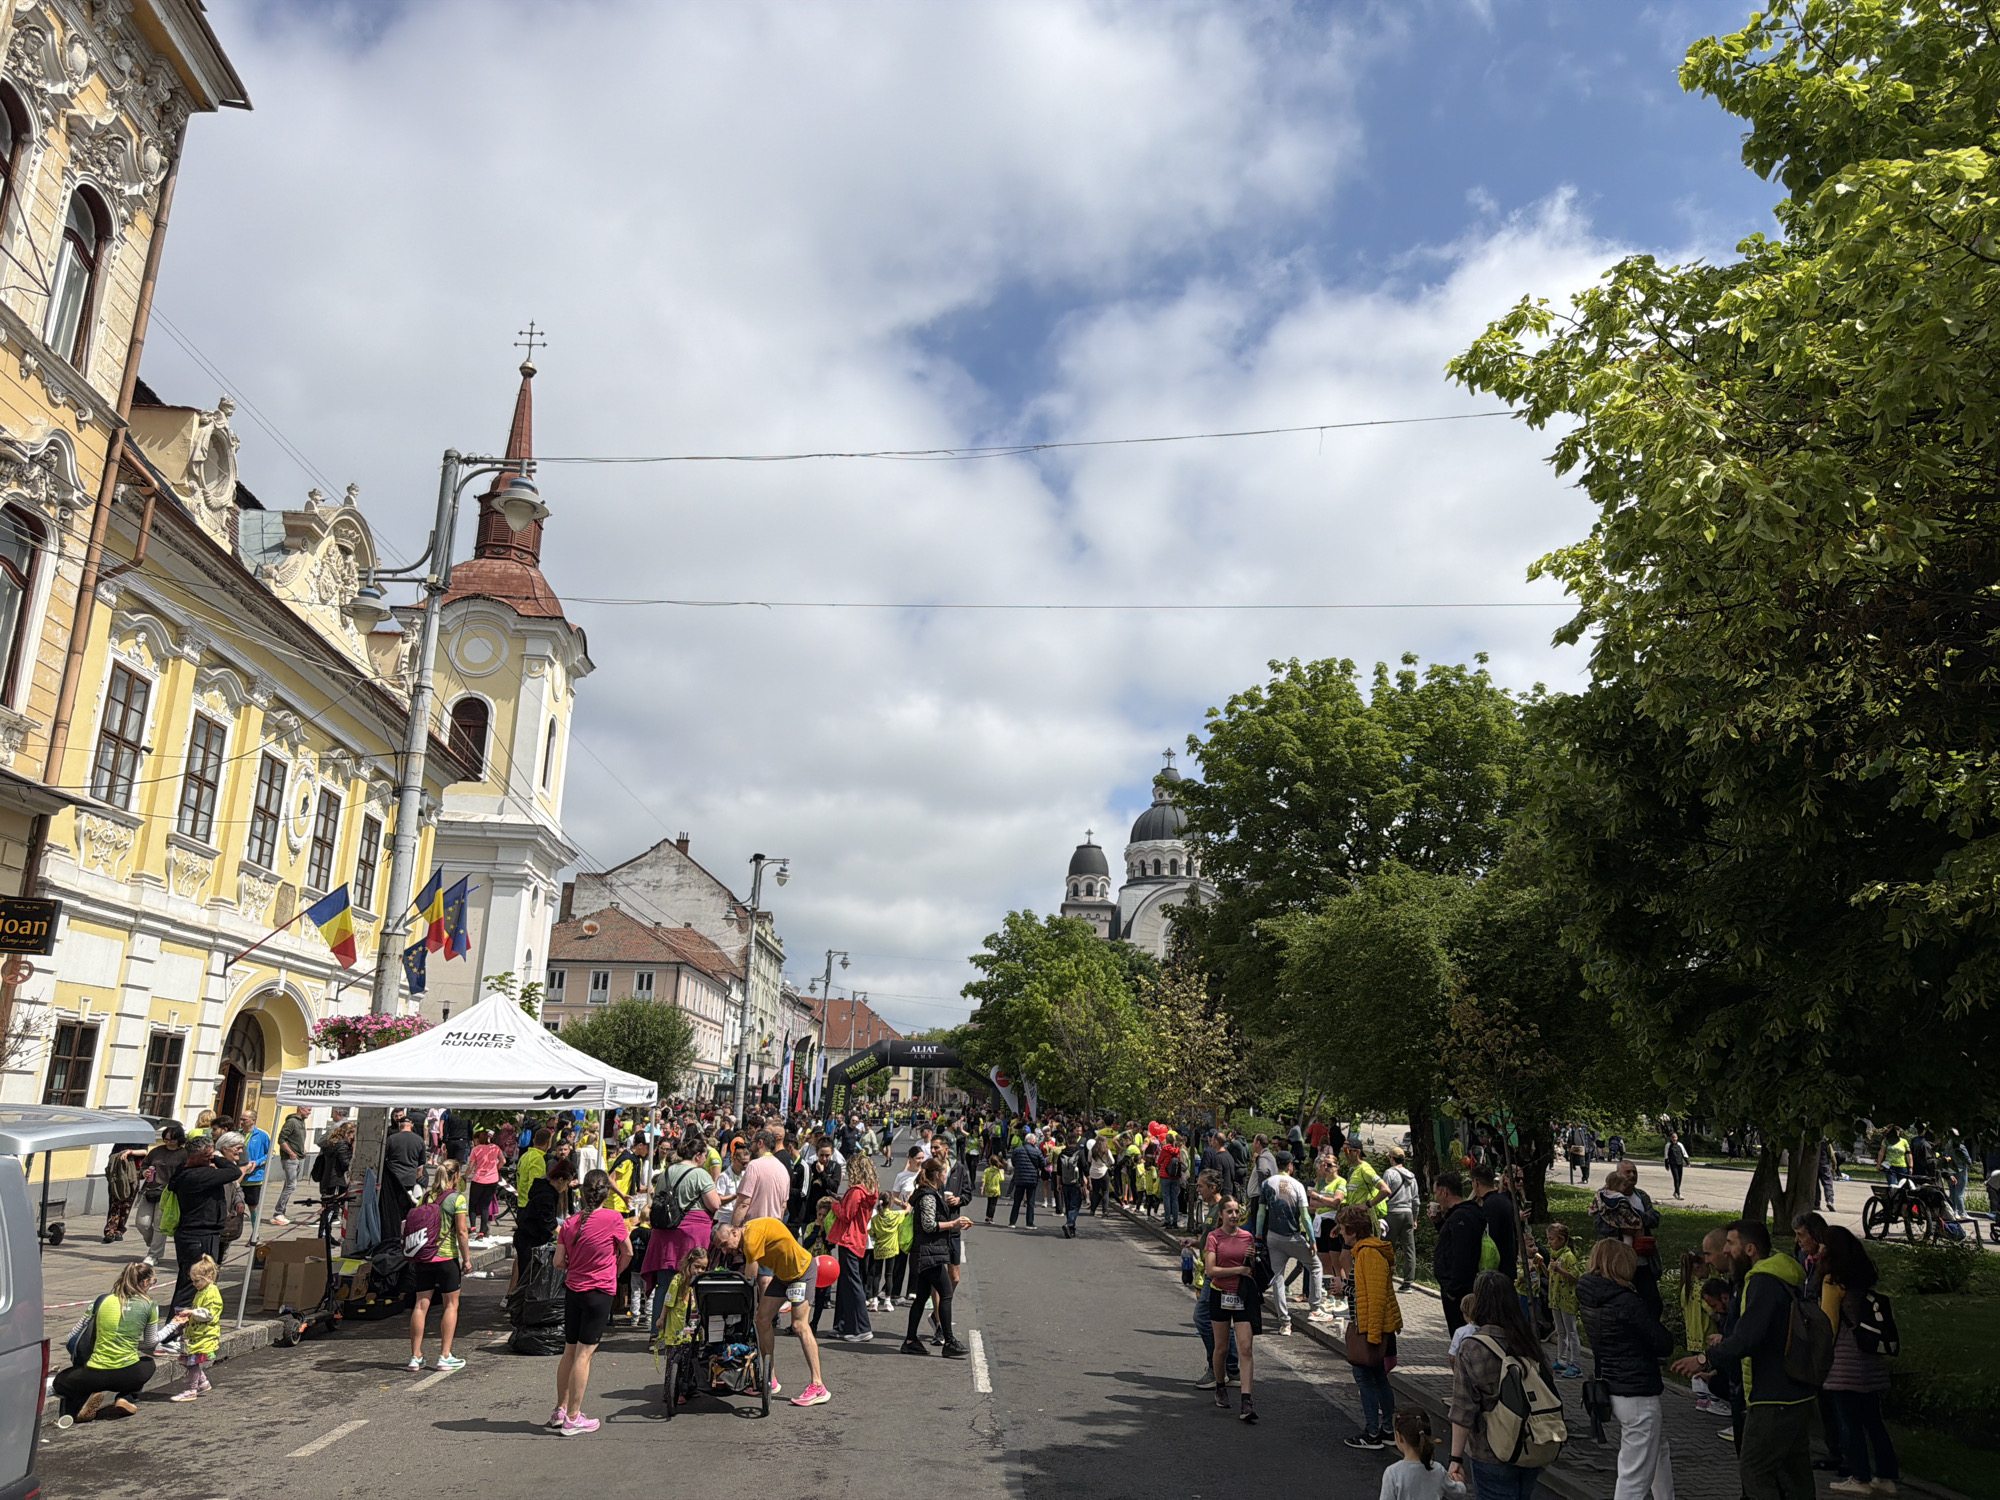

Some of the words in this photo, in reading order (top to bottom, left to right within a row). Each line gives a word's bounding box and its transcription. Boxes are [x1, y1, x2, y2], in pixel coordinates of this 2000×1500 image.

[445, 1031, 517, 1043] MURES
[441, 1039, 513, 1049] RUNNERS
[910, 1045, 939, 1053] ALIAT
[793, 1050, 803, 1093] MURES
[297, 1079, 342, 1089] MURES
[295, 1088, 341, 1097] RUNNERS
[836, 1084, 846, 1114] MURE
[405, 1227, 428, 1251] NIKE
